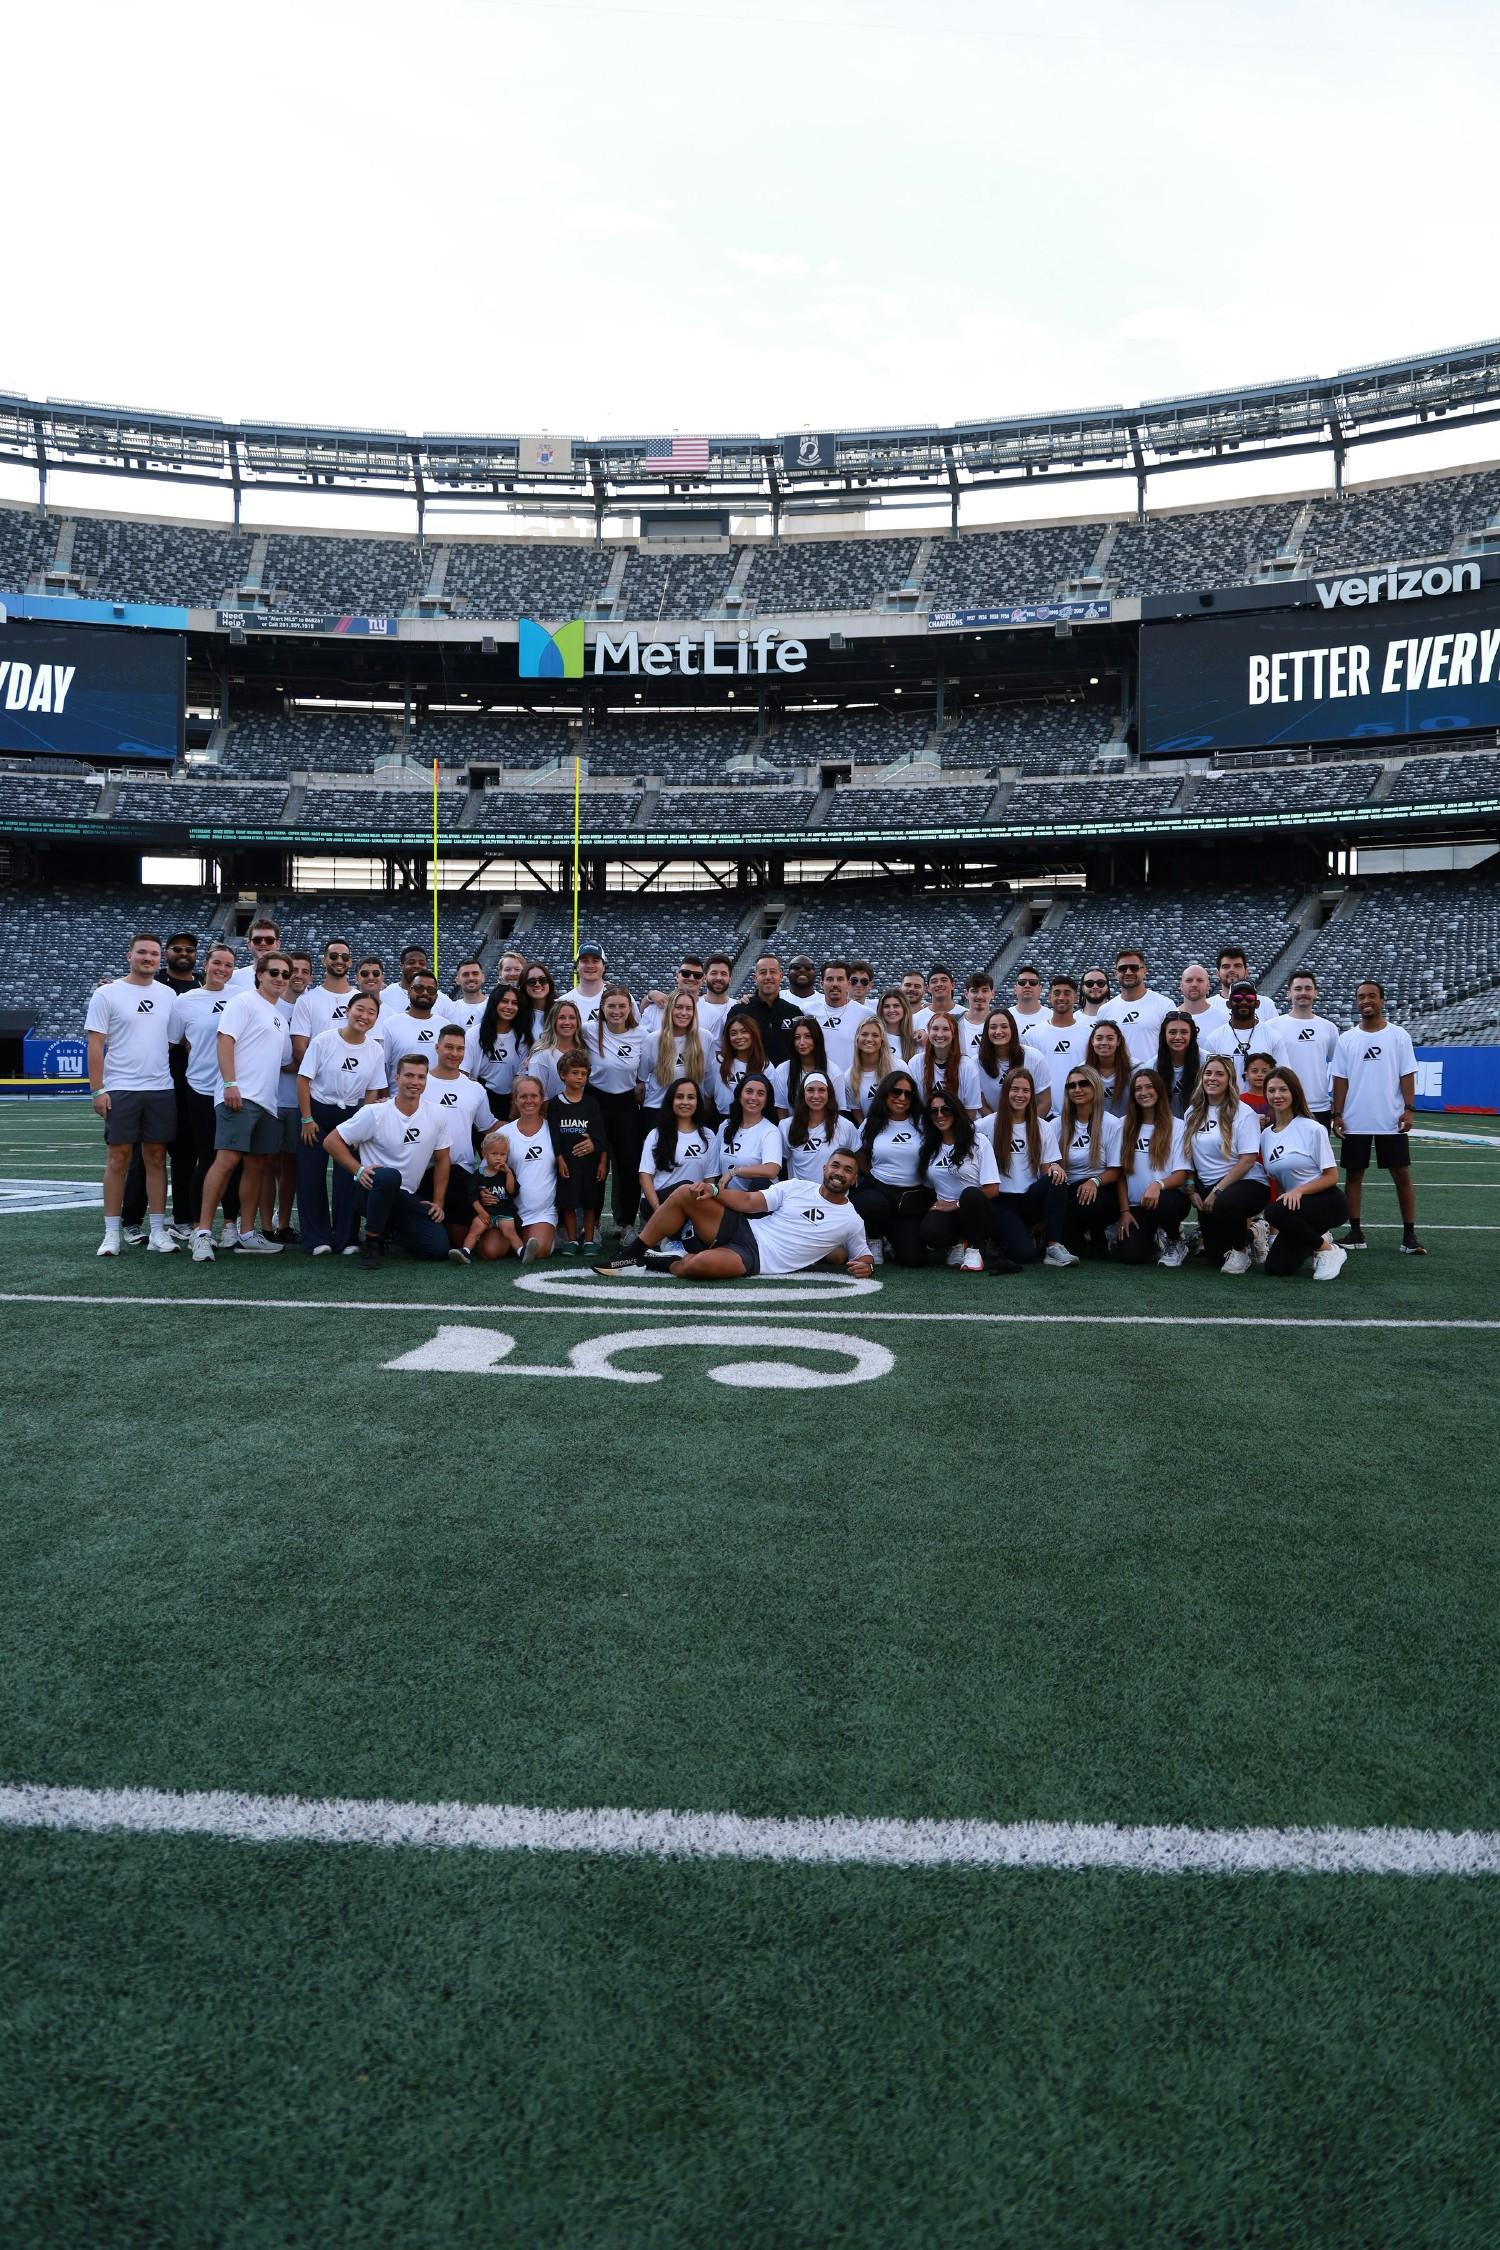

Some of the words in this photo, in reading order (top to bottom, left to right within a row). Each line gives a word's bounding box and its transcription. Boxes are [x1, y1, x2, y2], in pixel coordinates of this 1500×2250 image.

[1315, 562, 1481, 609] verizon
[934, 612, 957, 620] WORLD
[222, 619, 246, 627] Help?
[928, 619, 963, 628] CHAMPIONS
[594, 627, 808, 676] MetLife
[1249, 644, 1370, 706] BETTER
[1381, 628, 1500, 694] EVERY
[611, 1258, 637, 1268] BROOKS
